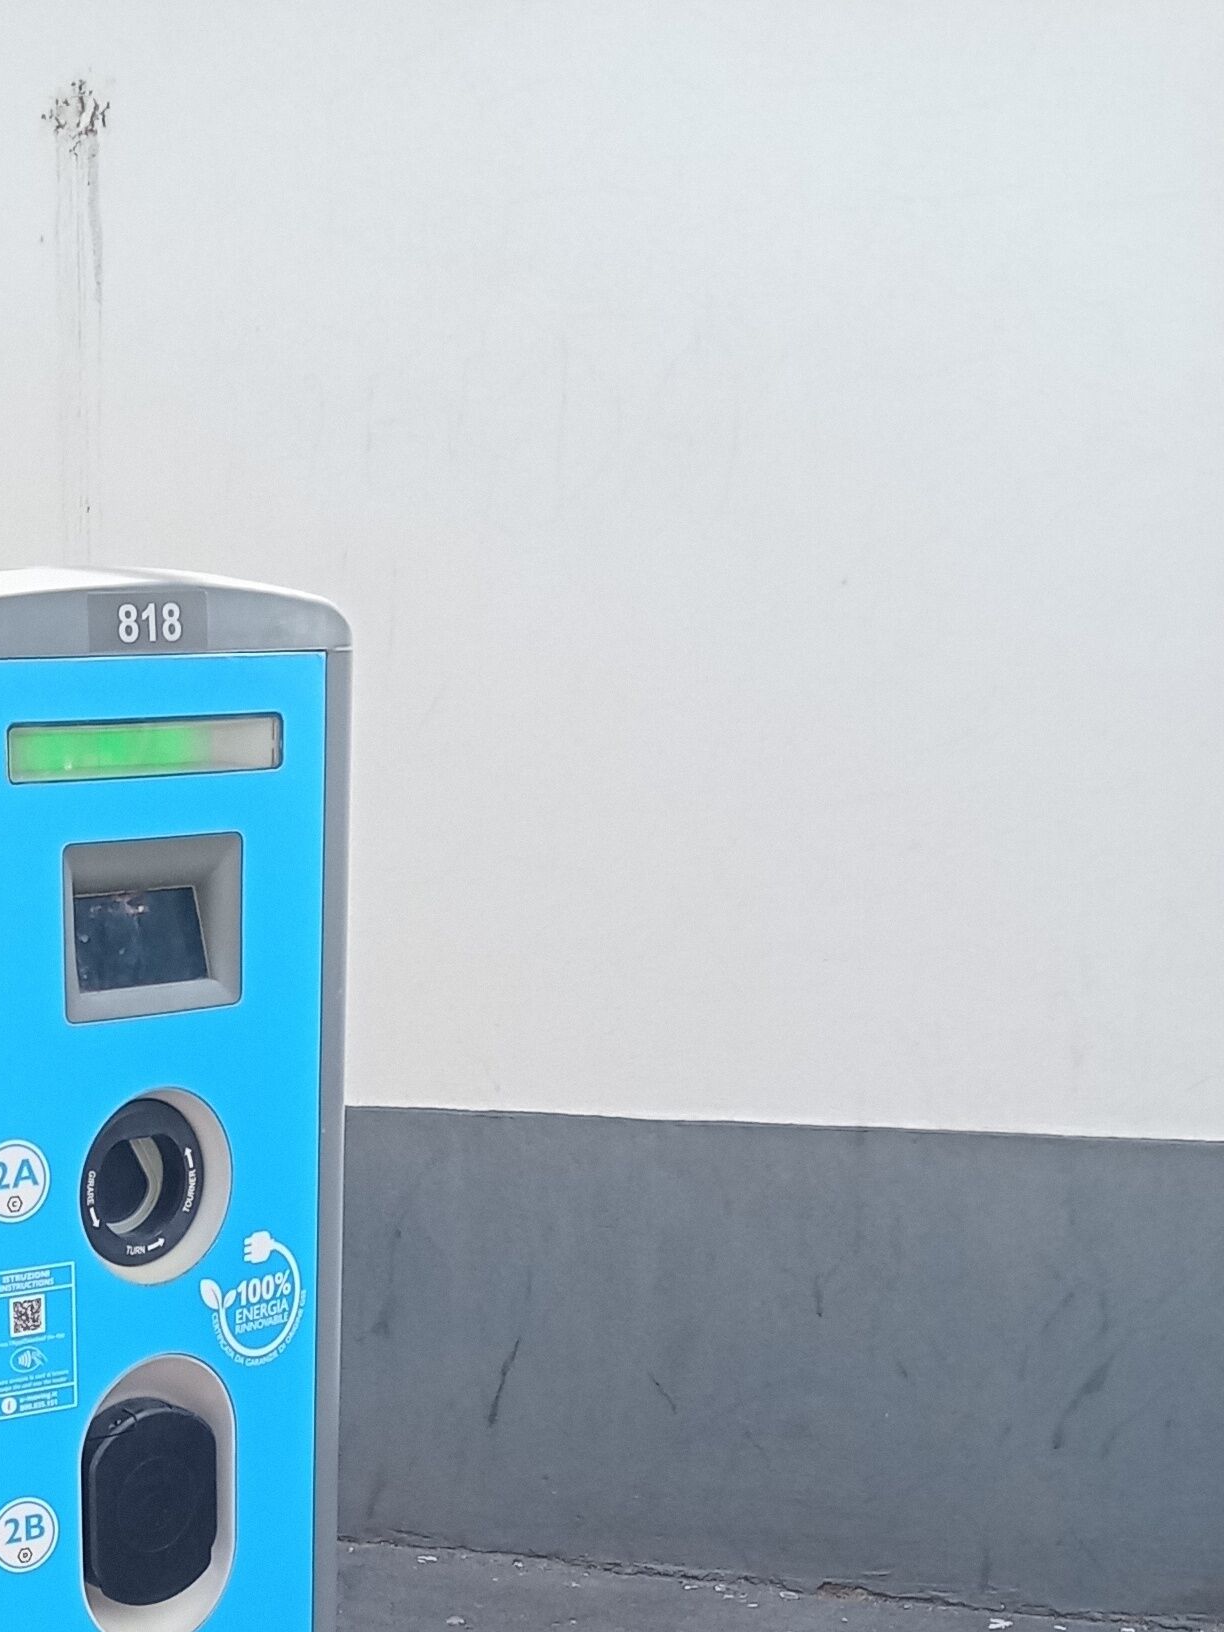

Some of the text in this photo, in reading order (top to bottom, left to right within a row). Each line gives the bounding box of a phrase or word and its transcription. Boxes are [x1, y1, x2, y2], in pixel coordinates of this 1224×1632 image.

[118, 602, 182, 643] 818
[86, 1170, 97, 1206] GIRARE
[182, 1168, 197, 1213] TOURNER
[126, 1244, 146, 1256] TURN
[236, 1269, 292, 1306] 100%
[235, 1297, 290, 1324] ENERGIA
[235, 1311, 290, 1335] RINNOVABILE
[4, 1513, 45, 1545] 2B
